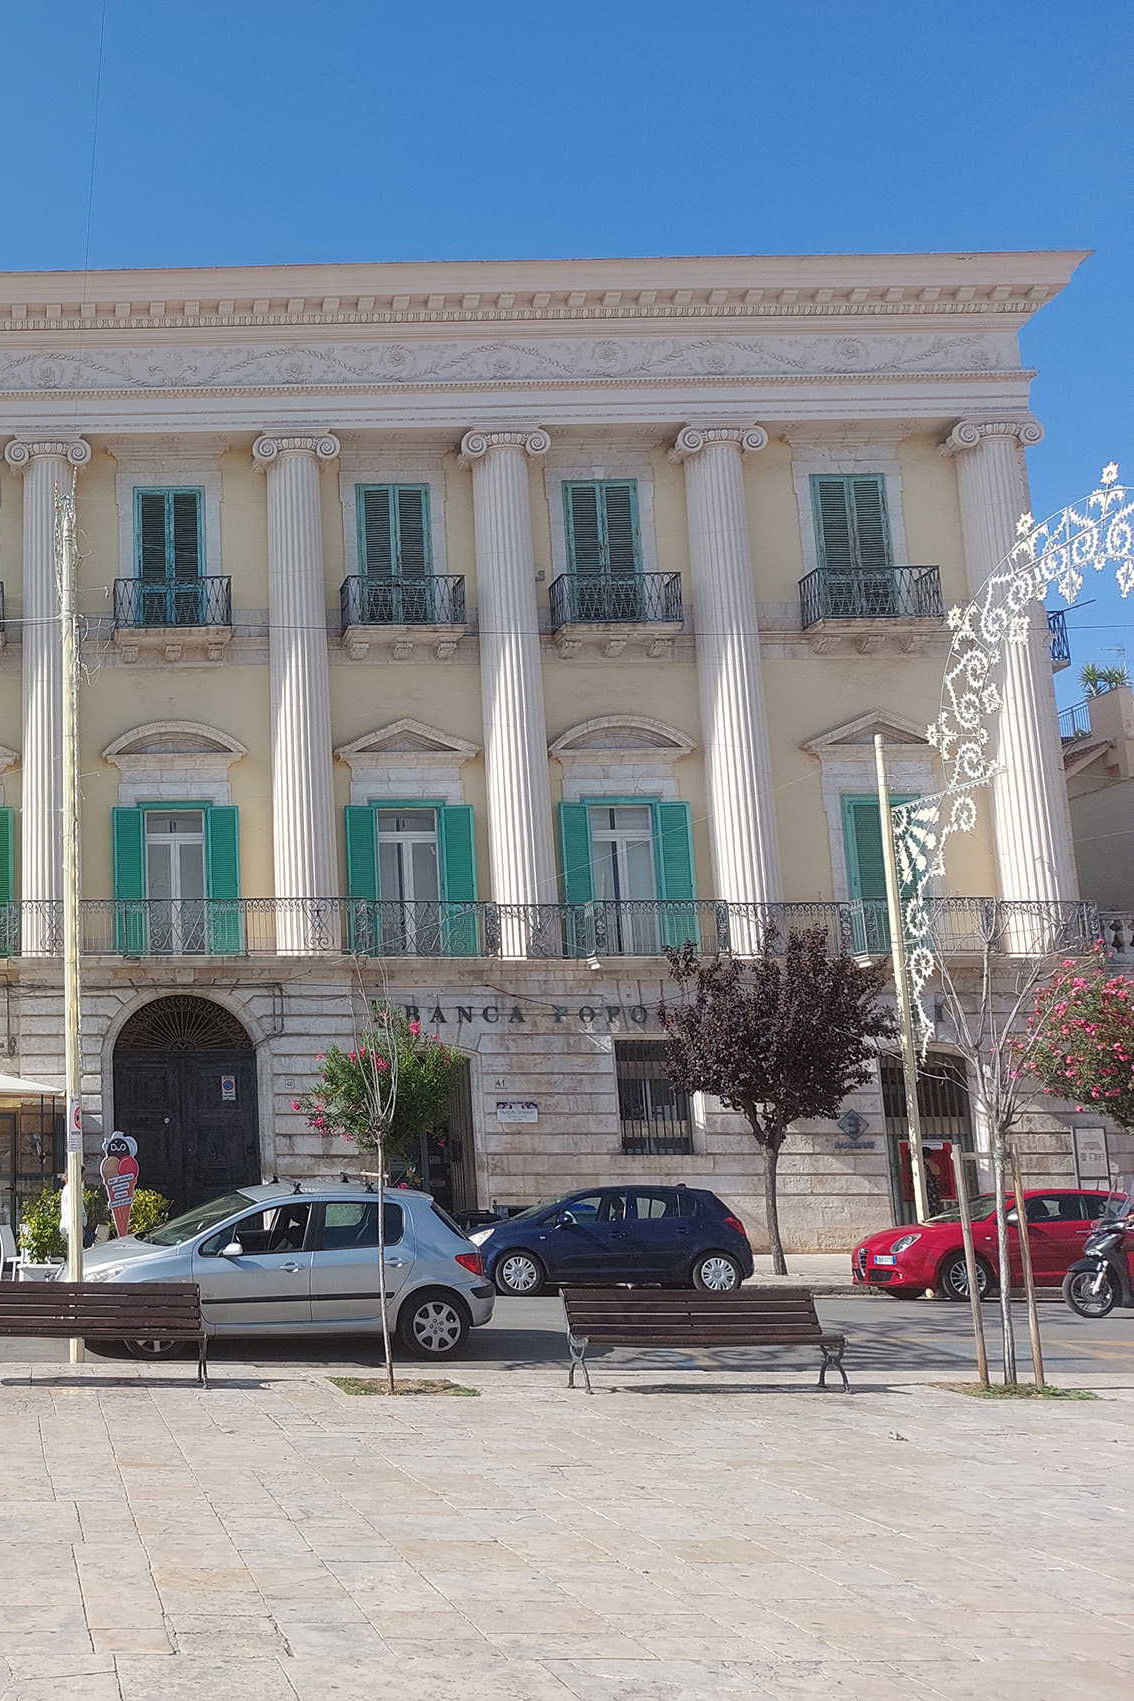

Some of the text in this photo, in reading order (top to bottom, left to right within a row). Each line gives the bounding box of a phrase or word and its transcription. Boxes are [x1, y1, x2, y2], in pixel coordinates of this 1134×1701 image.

[405, 1005, 527, 1023] BANCA
[496, 1079, 506, 1087] 41
[110, 1143, 127, 1152] DUO
